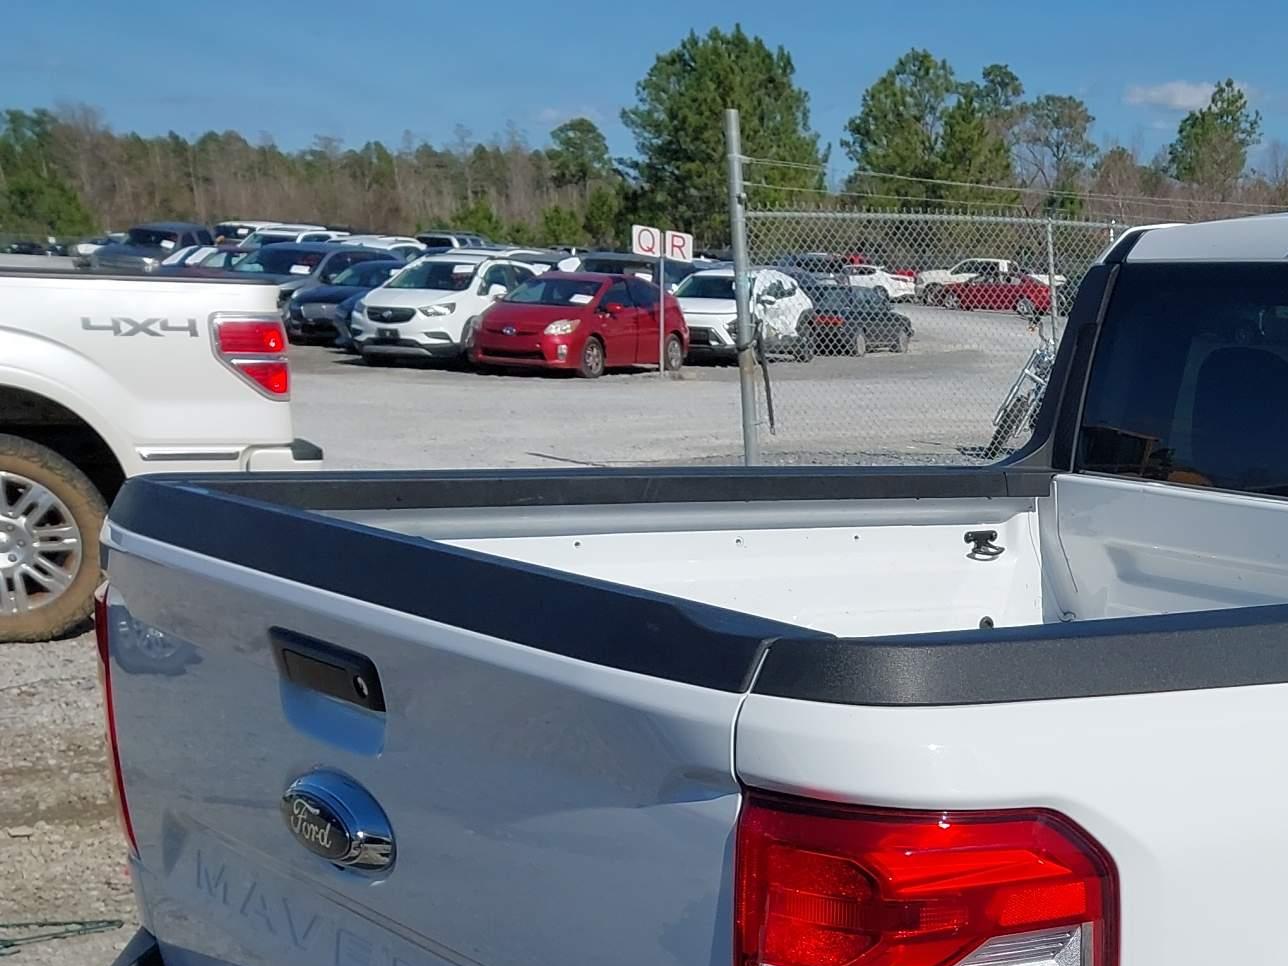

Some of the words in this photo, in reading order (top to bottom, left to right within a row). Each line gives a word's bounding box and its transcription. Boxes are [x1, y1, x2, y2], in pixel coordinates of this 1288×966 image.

[638, 228, 656, 255] Q
[671, 234, 687, 260] R
[290, 798, 332, 848] Ford
